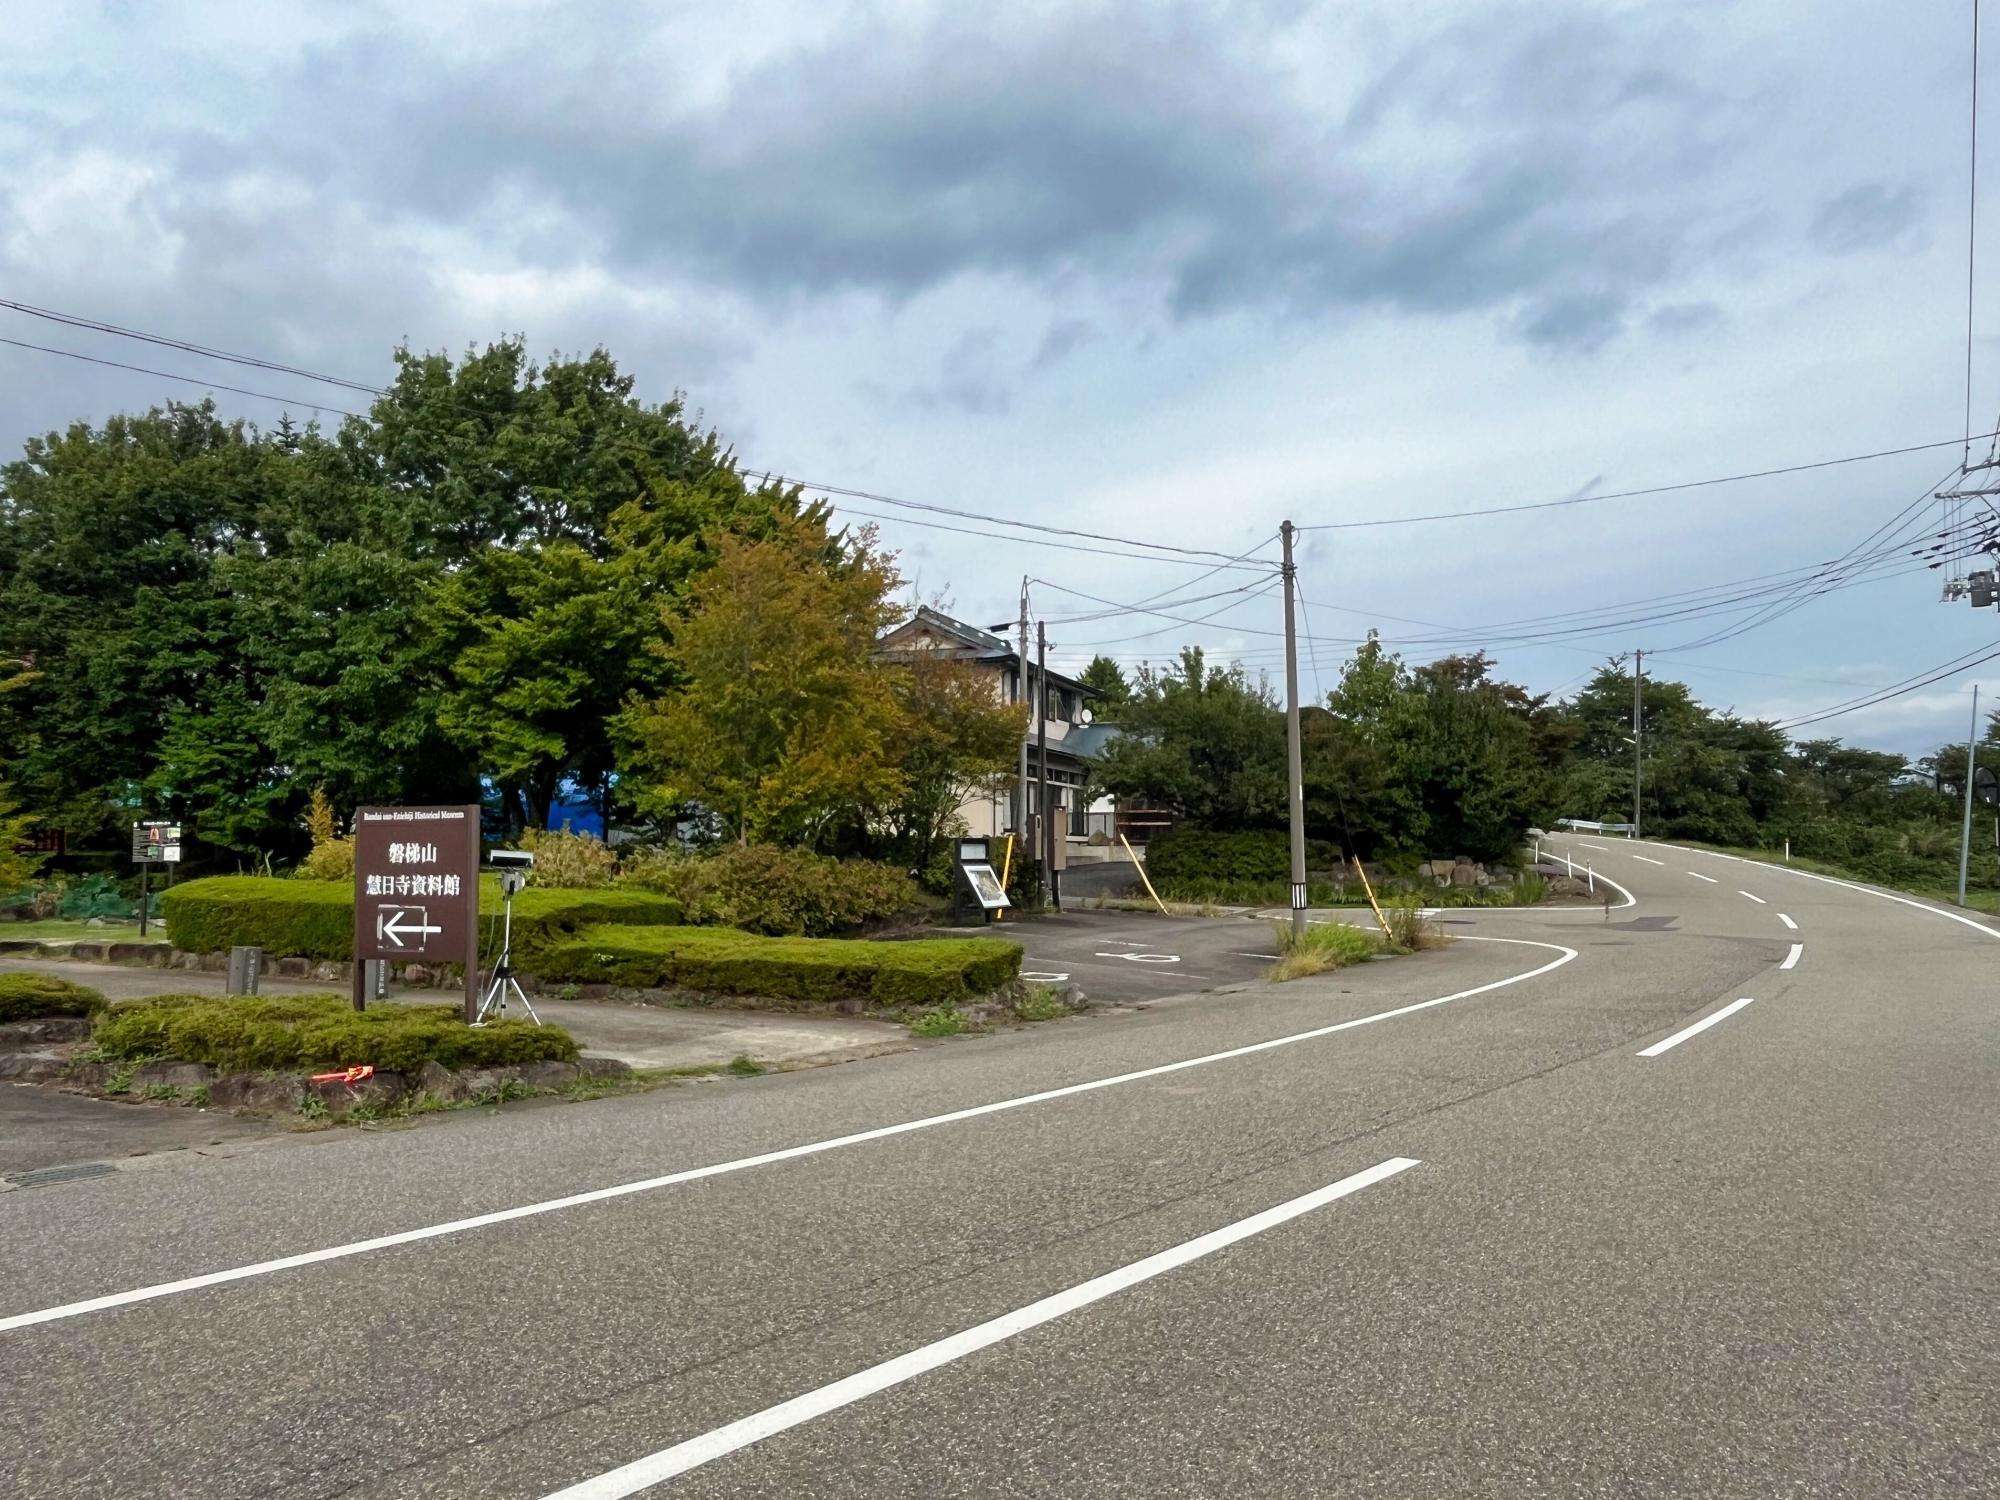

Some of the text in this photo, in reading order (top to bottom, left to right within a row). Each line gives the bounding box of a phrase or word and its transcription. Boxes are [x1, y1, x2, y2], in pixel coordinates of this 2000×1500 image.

[415, 811, 440, 820] Historical
[388, 842, 437, 863] 磐梯山
[366, 874, 460, 896] 慧日寺資料館
